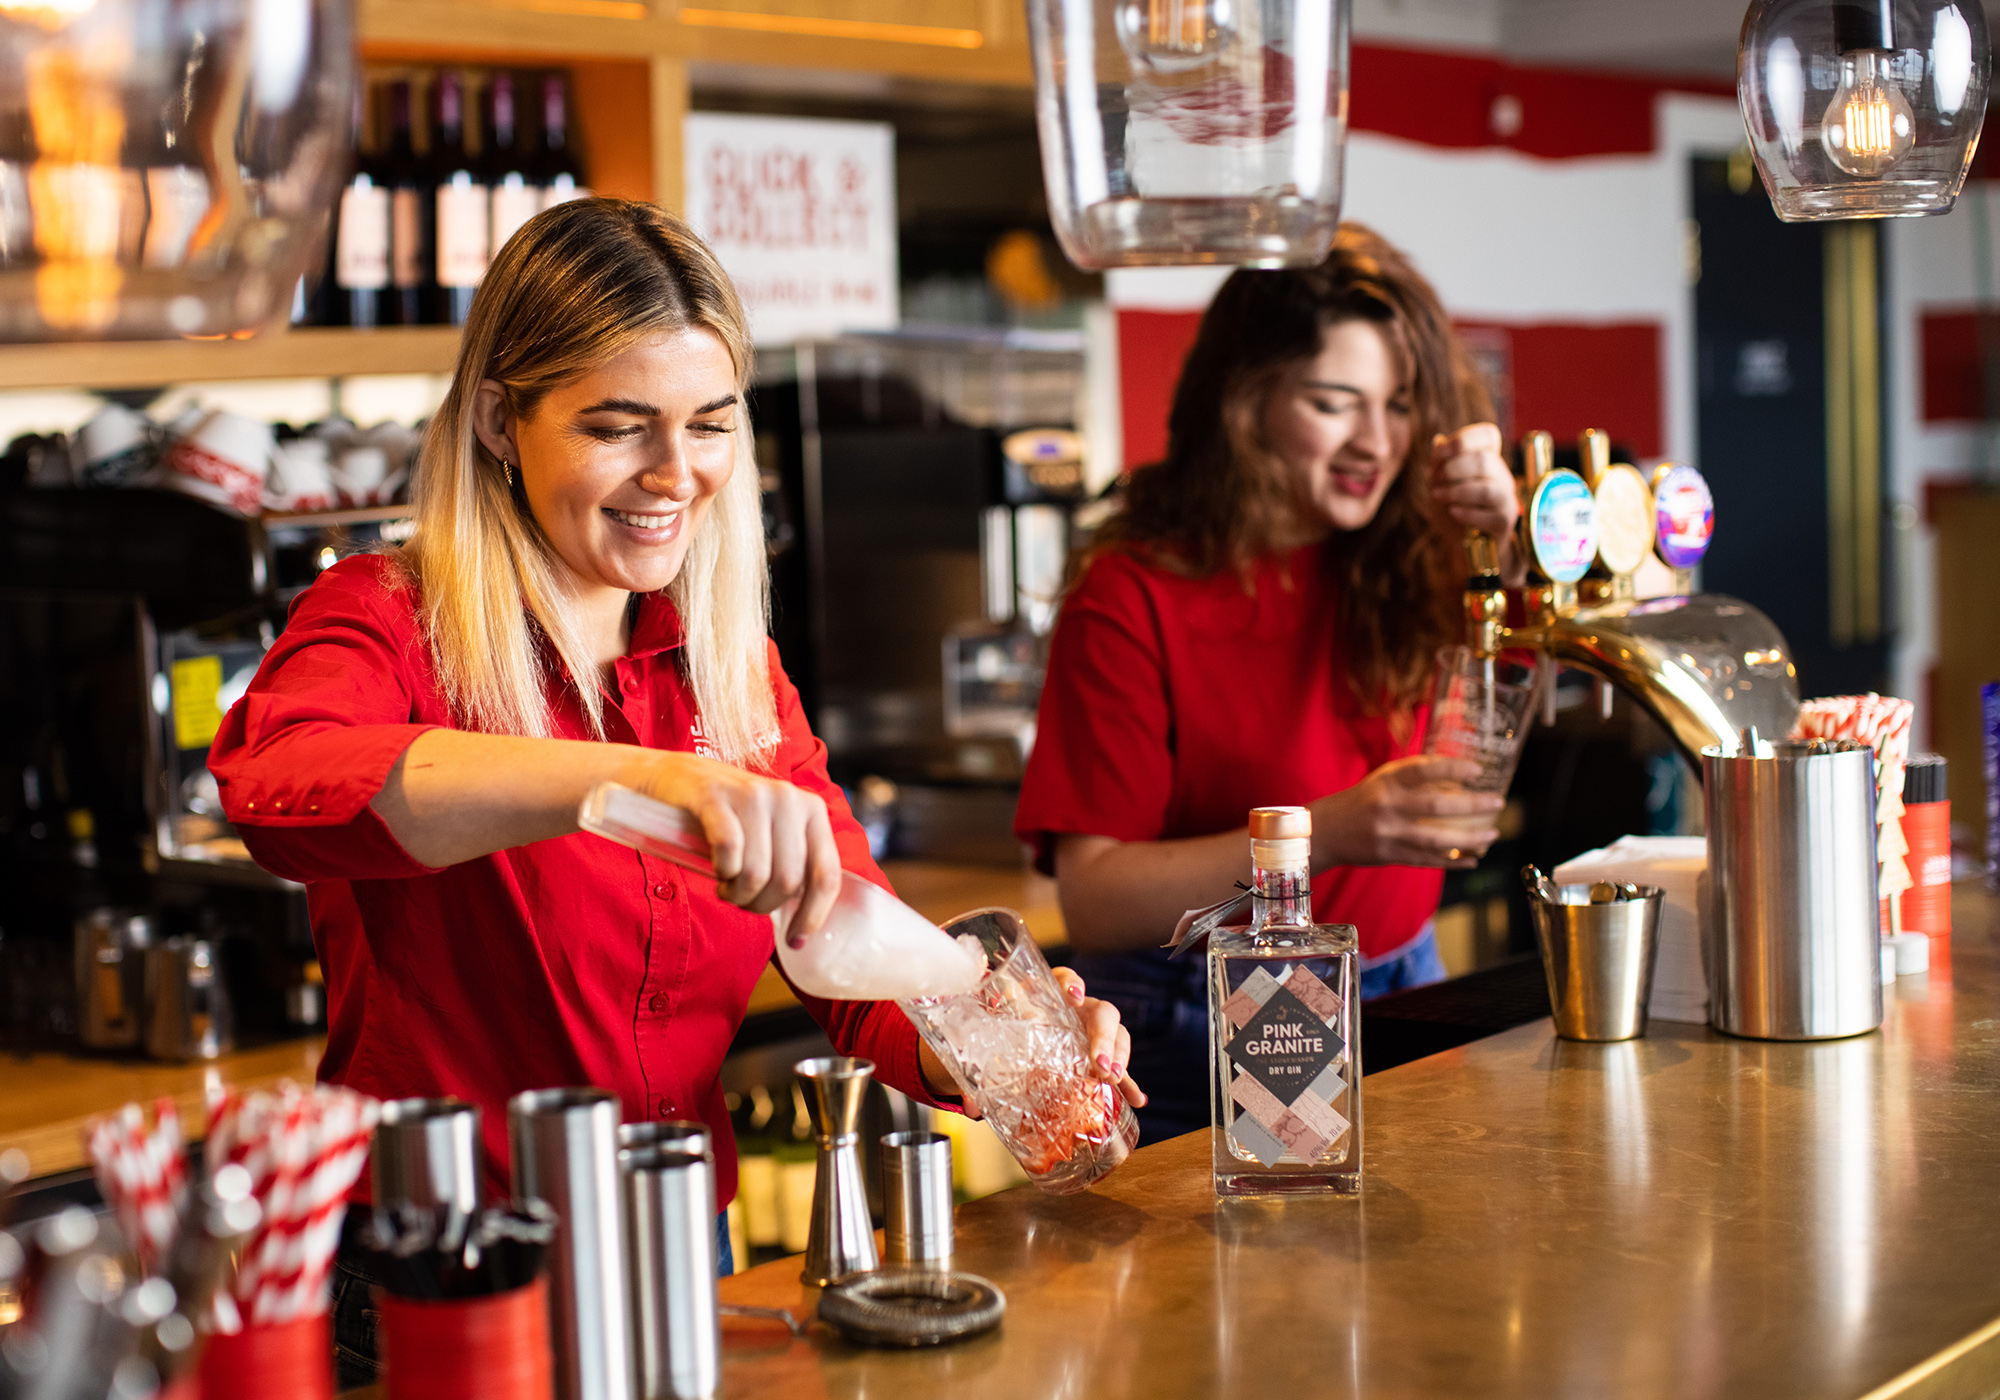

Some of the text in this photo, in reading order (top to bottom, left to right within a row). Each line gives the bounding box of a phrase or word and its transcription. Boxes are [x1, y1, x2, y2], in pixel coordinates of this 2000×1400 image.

[1263, 1023, 1304, 1039] PINK
[1245, 1038, 1323, 1056] GRANITE
[1268, 1065, 1302, 1075] DRY GIN
